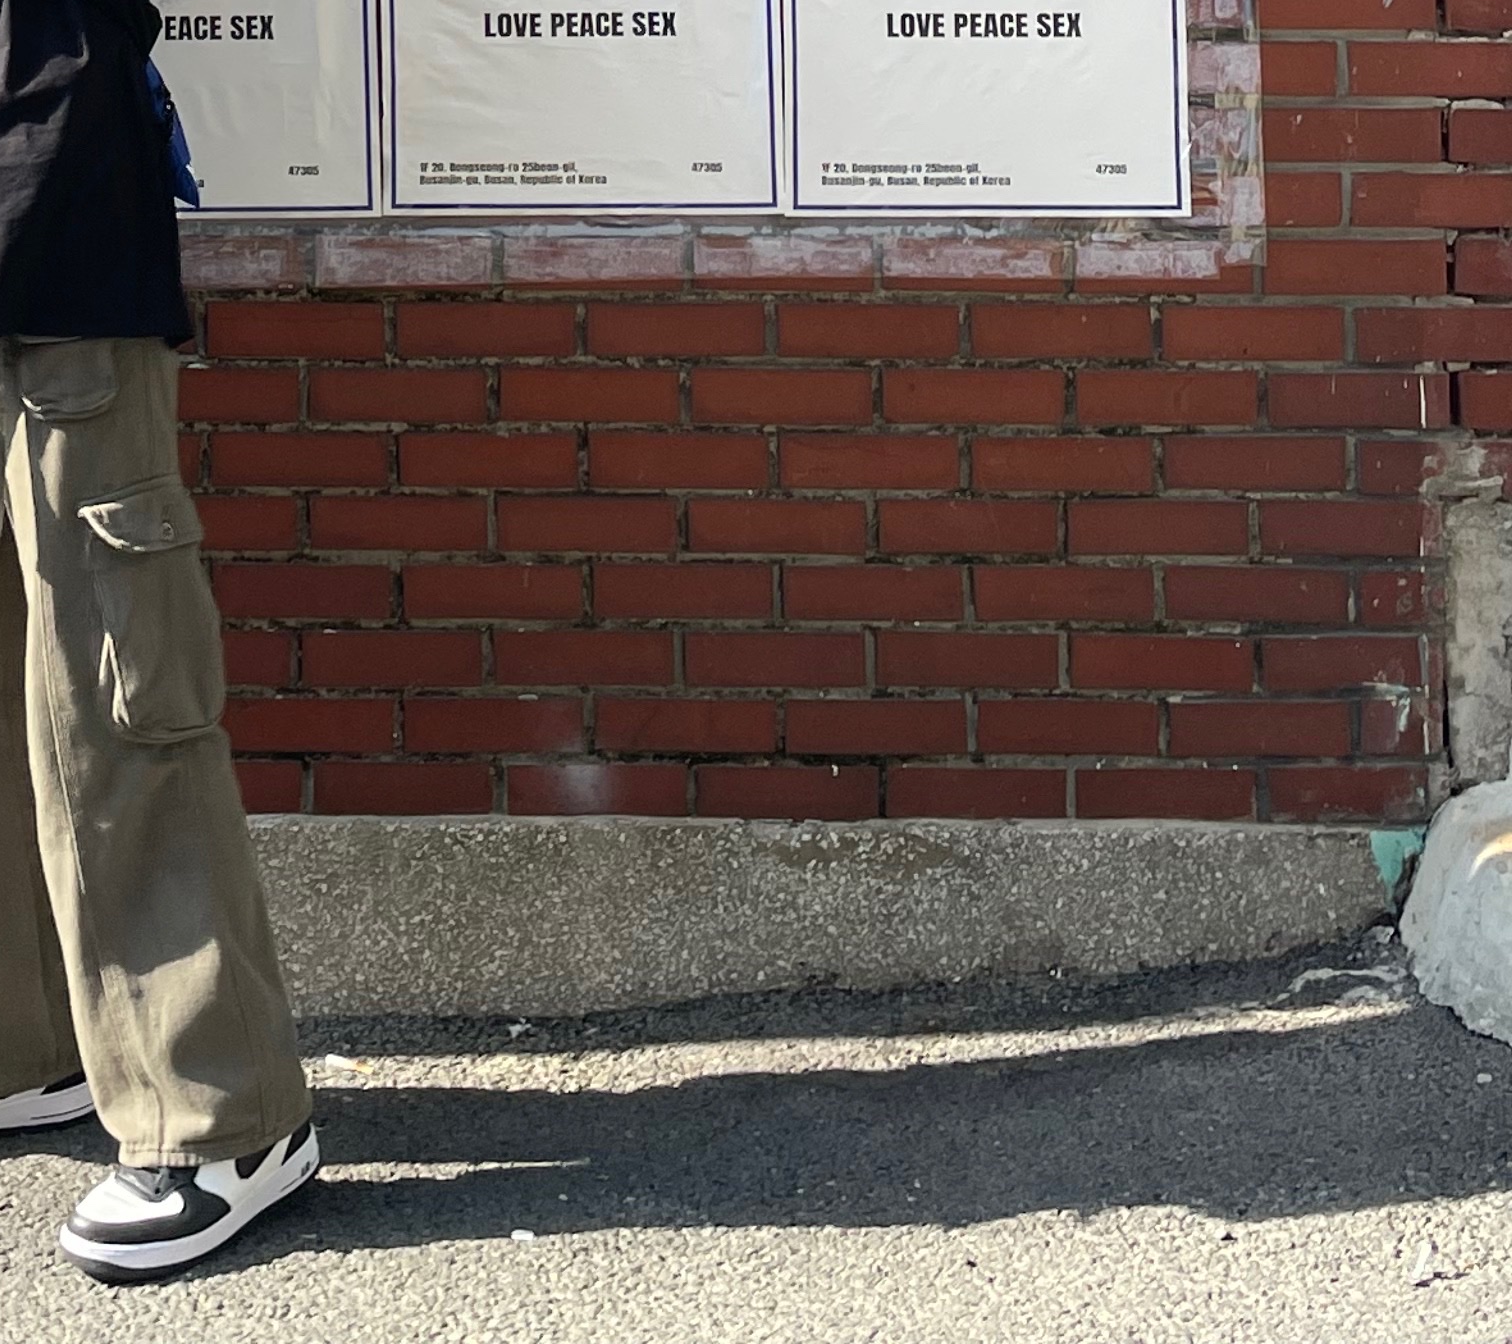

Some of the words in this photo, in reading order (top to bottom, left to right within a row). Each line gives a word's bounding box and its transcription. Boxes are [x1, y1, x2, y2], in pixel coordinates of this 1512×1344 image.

[163, 15, 223, 41] EACE
[230, 15, 274, 40] SEX
[484, 12, 542, 37] LOVE
[550, 12, 624, 37] PEACE
[632, 11, 676, 36] SEX
[887, 13, 944, 38] LOVE
[954, 13, 1028, 38] PEACE
[1037, 13, 1081, 37] SEX
[579, 175, 607, 185] Korea
[982, 176, 1011, 186] Korea
